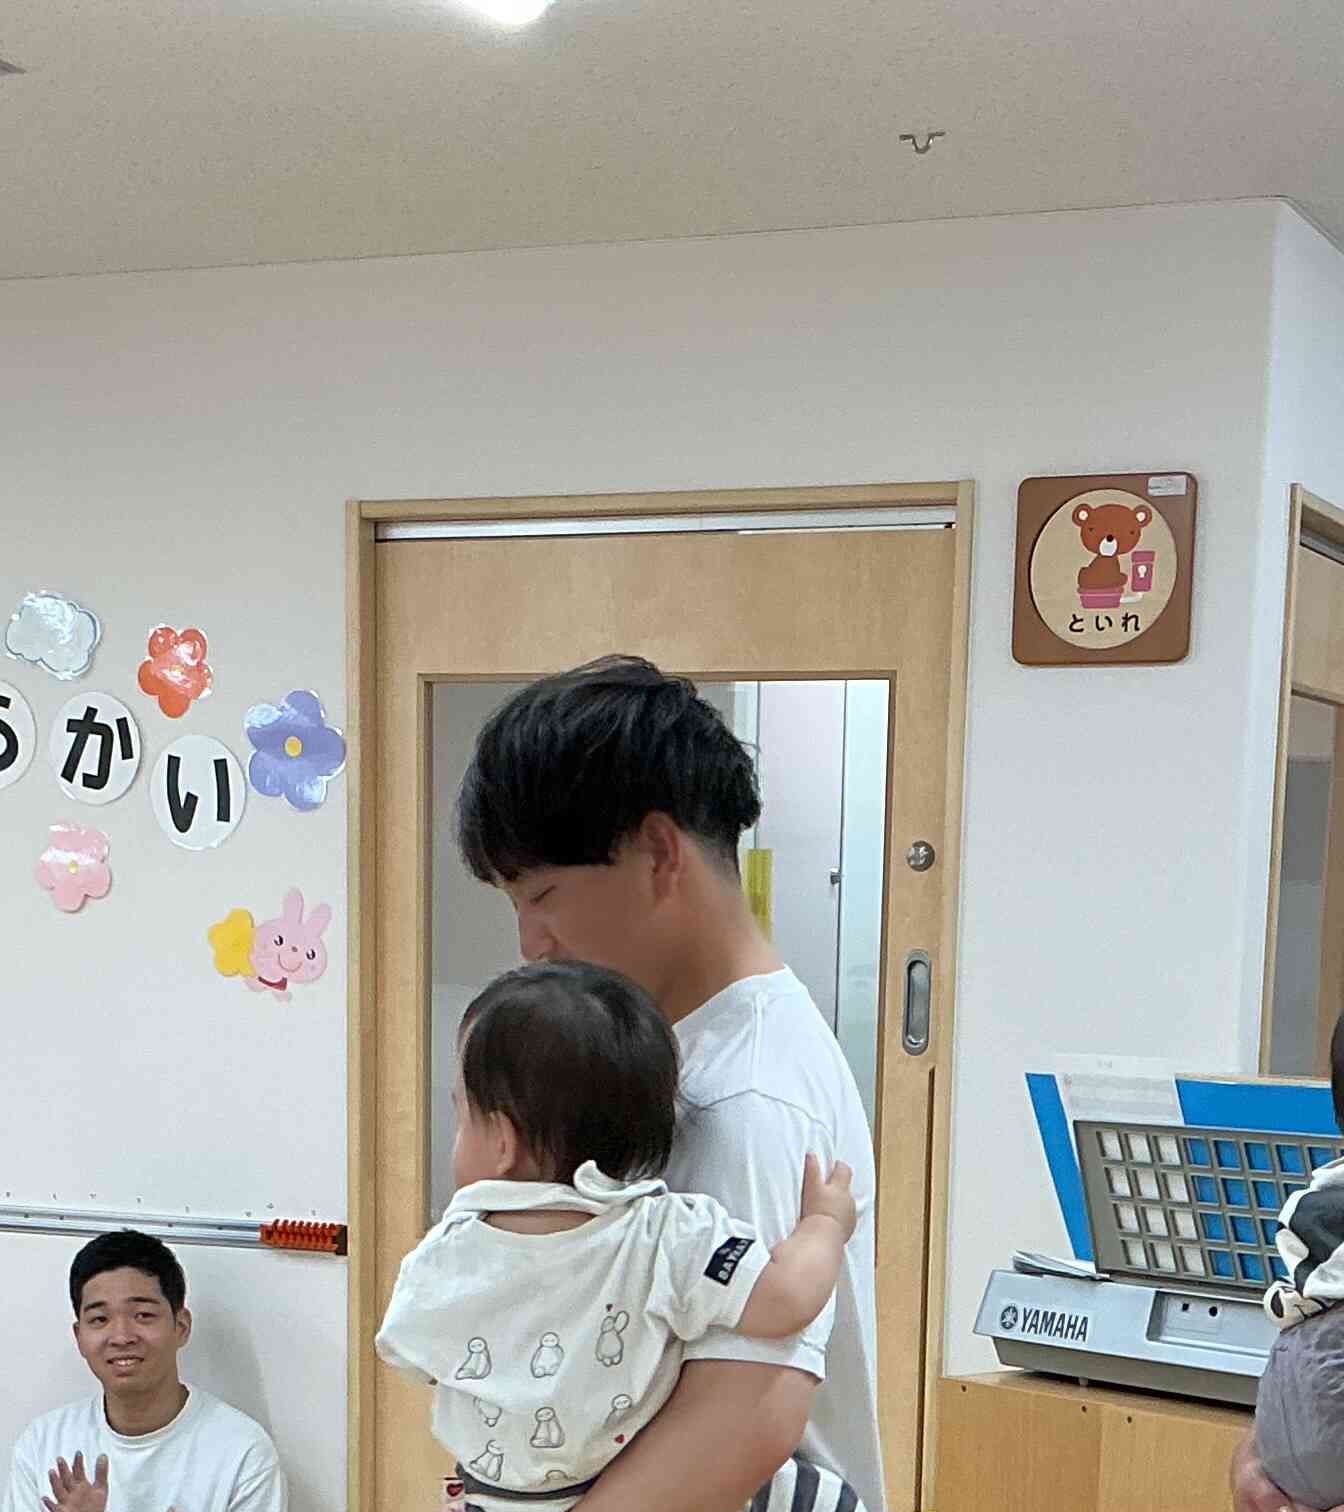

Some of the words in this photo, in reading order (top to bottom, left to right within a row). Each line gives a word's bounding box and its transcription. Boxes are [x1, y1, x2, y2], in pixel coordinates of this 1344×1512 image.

[1068, 612, 1140, 633] といれ
[1021, 1306, 1089, 1343] YAMAHA
